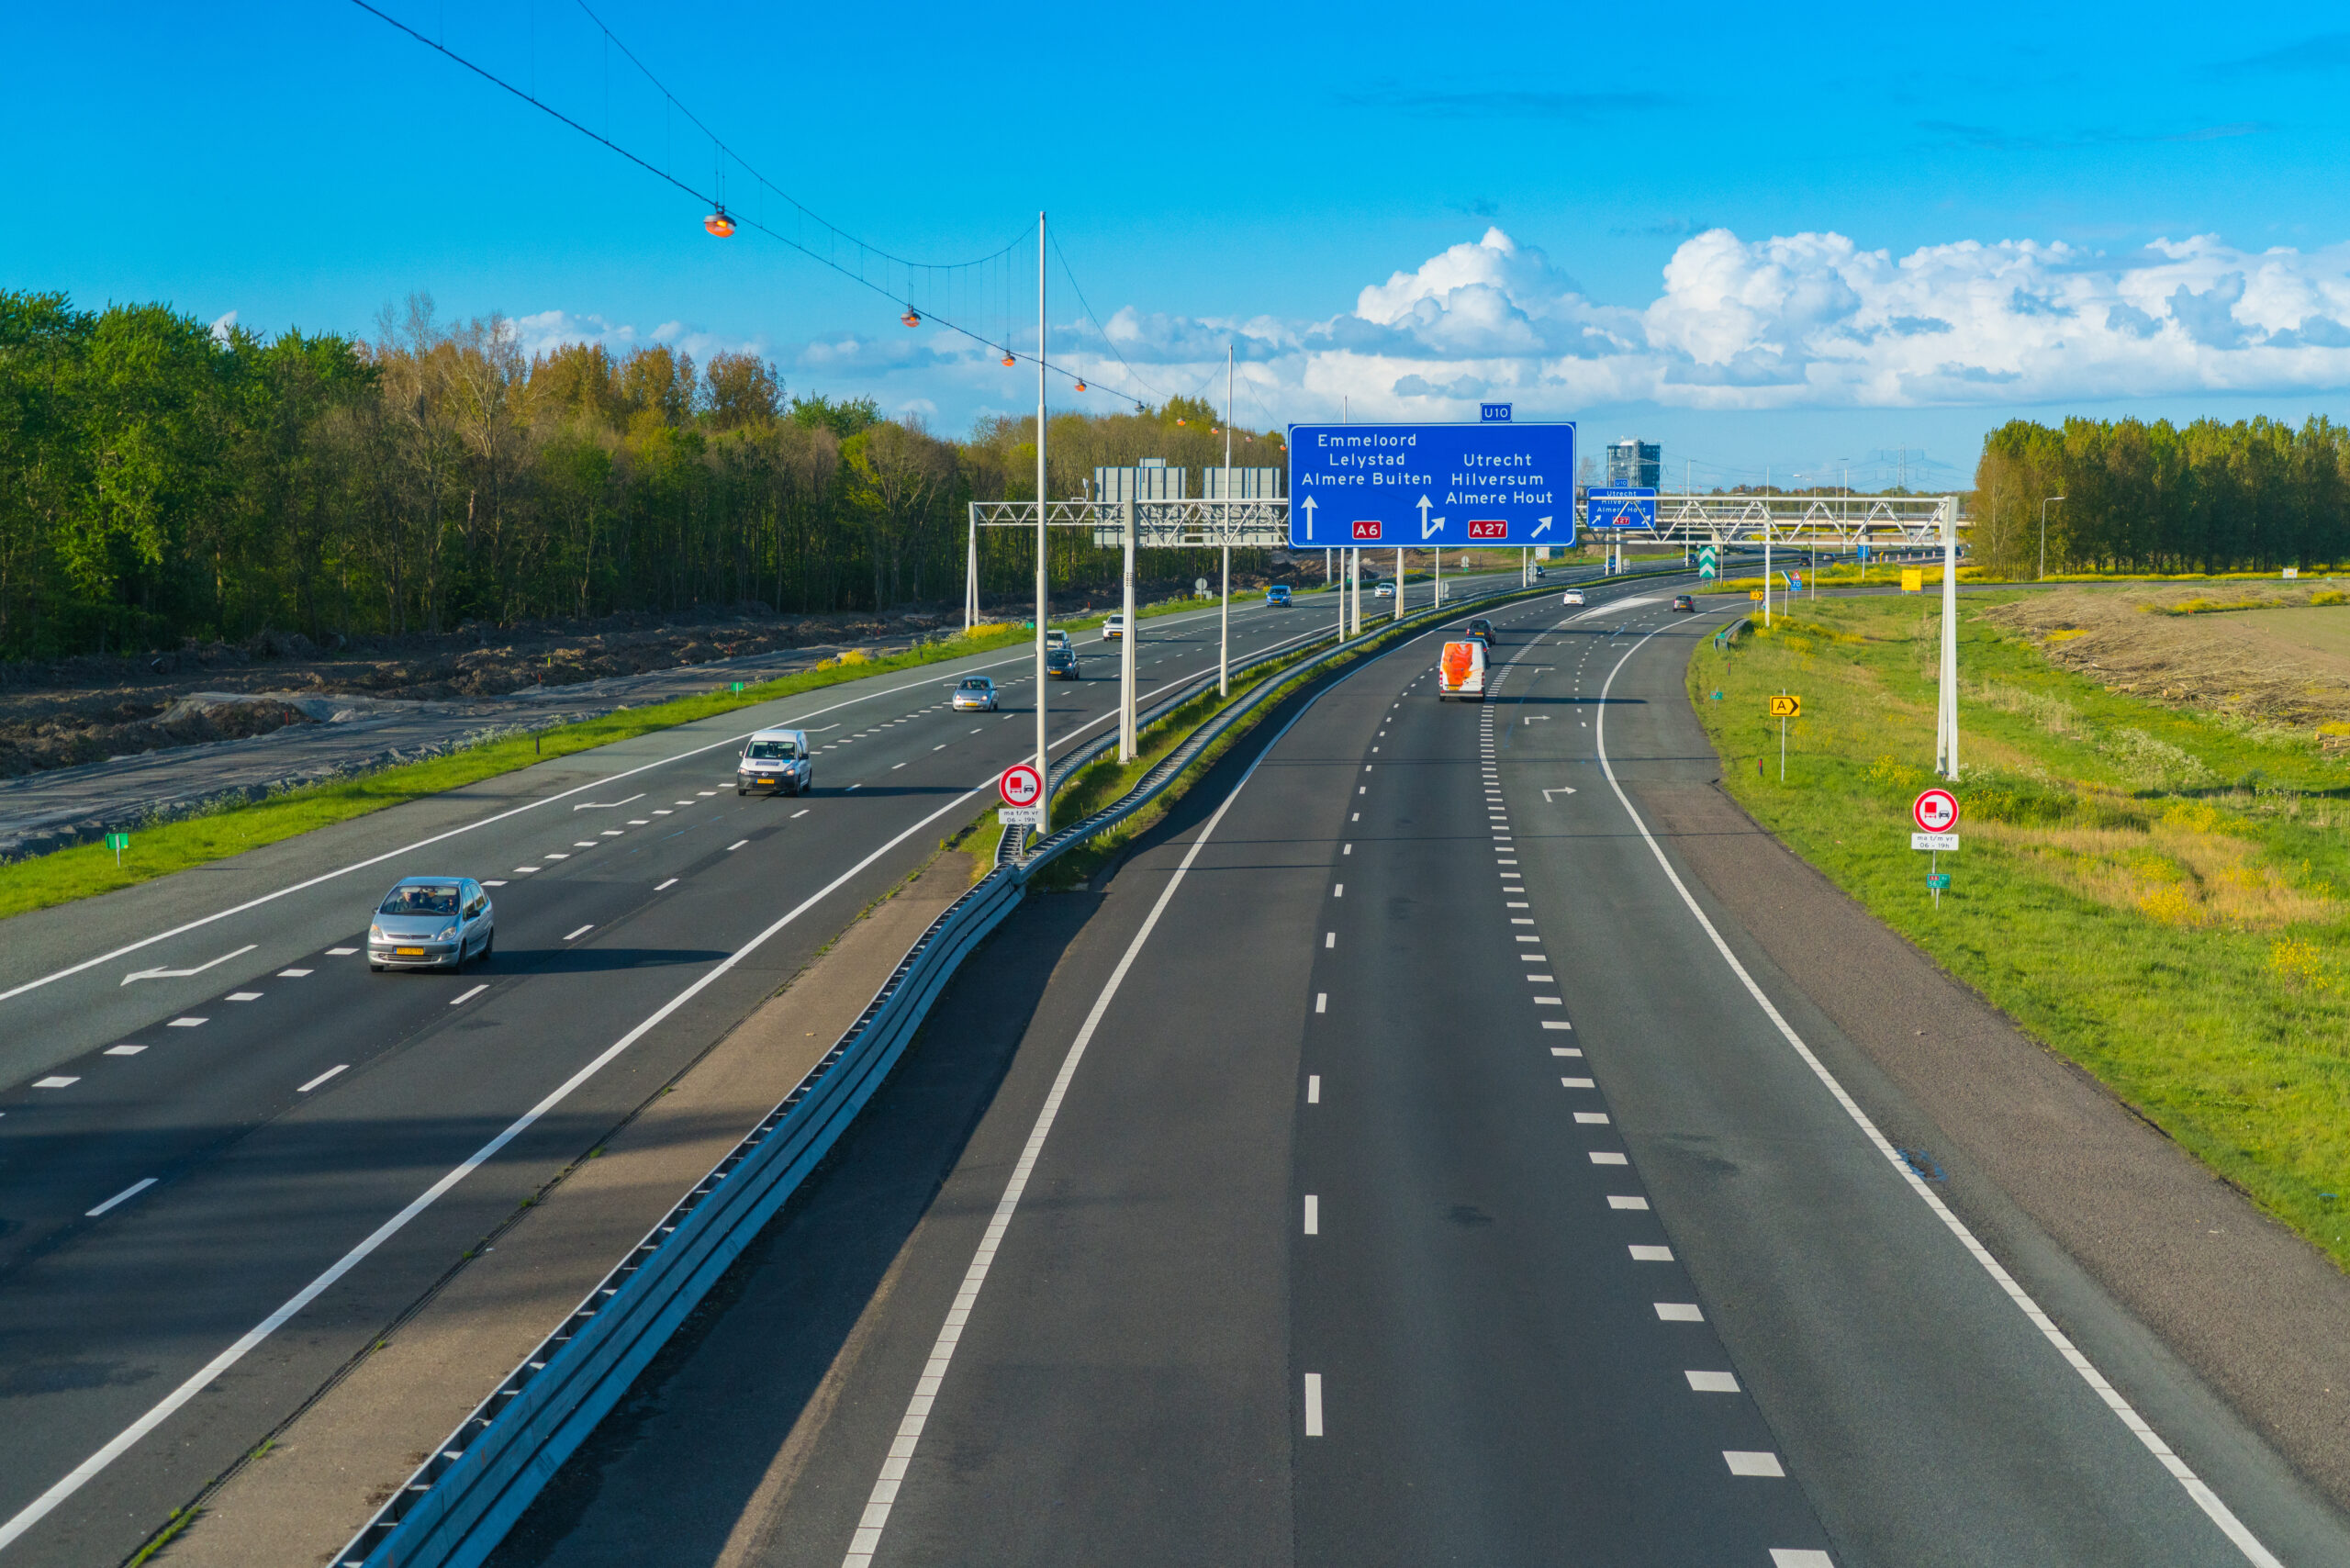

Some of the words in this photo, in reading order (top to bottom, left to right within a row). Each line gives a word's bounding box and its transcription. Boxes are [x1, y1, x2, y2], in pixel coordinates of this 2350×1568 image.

[1484, 408, 1508, 418] U10
[1318, 433, 1416, 447] Emmeloord
[1329, 453, 1404, 469] Lelystad
[1463, 454, 1532, 466] Utrecht
[1302, 473, 1365, 486] Almere
[1372, 472, 1432, 485] Buiten
[1451, 473, 1544, 486] Hilversum
[1445, 492, 1507, 505] Almere
[1513, 491, 1553, 504] Hout
[1356, 524, 1378, 536] A6
[1472, 523, 1505, 535] A27
[1776, 700, 1786, 711] A
